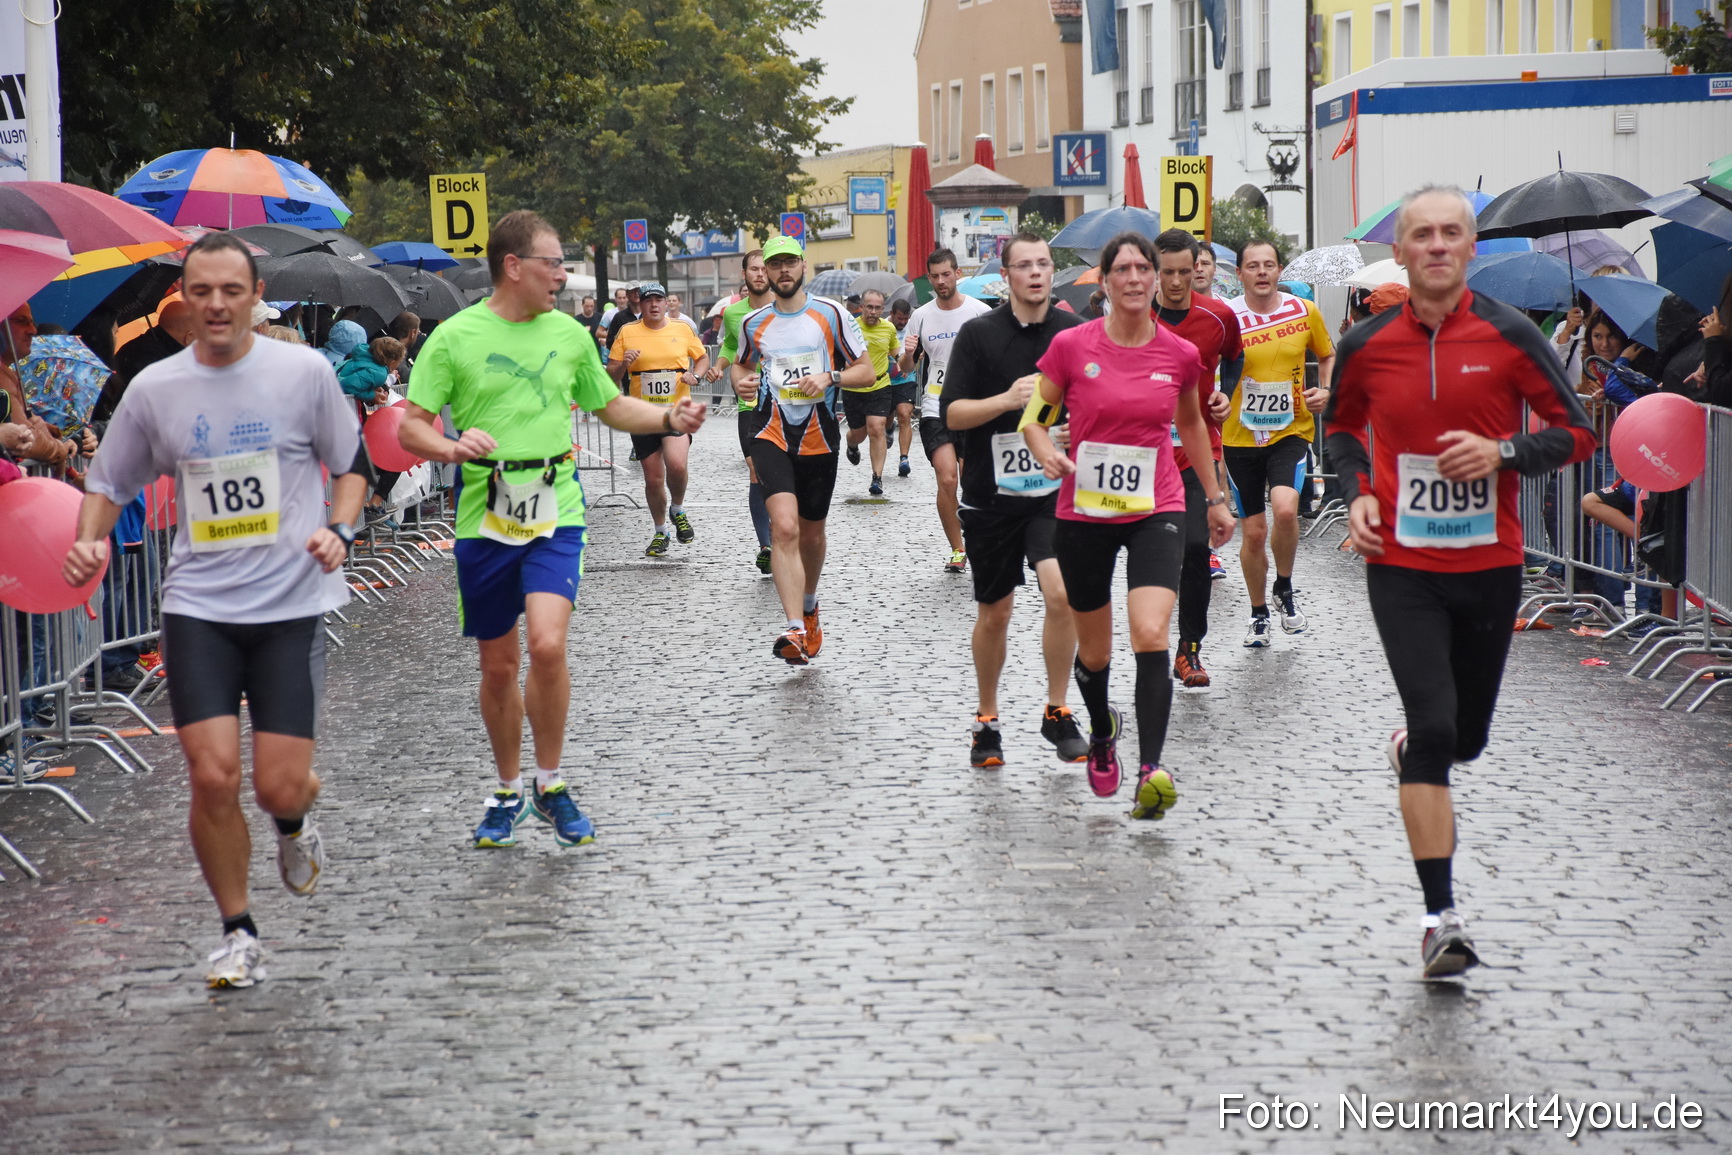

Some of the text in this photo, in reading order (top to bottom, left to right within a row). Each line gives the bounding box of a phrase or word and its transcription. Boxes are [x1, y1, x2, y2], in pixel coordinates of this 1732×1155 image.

[1060, 139, 1101, 176] K&L
[1167, 159, 1206, 175] Block
[437, 177, 480, 193] Block
[1173, 181, 1199, 223] D
[446, 200, 474, 240] D
[627, 242, 646, 250] TAXI
[347, 252, 366, 262] knoll
[928, 331, 958, 342] DELP
[1241, 322, 1311, 349] MAX BÖGL
[782, 366, 811, 386] 215
[937, 369, 944, 384] 2
[1150, 372, 1172, 383] ANITA
[647, 381, 670, 394] 103
[1246, 393, 1289, 412] 2728
[1253, 416, 1281, 424] Andreas
[1002, 448, 1044, 474] 28
[1024, 479, 1044, 489] Alex
[1094, 462, 1141, 492] 189
[202, 476, 265, 515] 183
[1101, 496, 1127, 510] Anita
[1409, 478, 1489, 512] 2099
[208, 518, 268, 539] Bernhard
[507, 524, 534, 538] Horst
[1427, 520, 1471, 536] Robert
